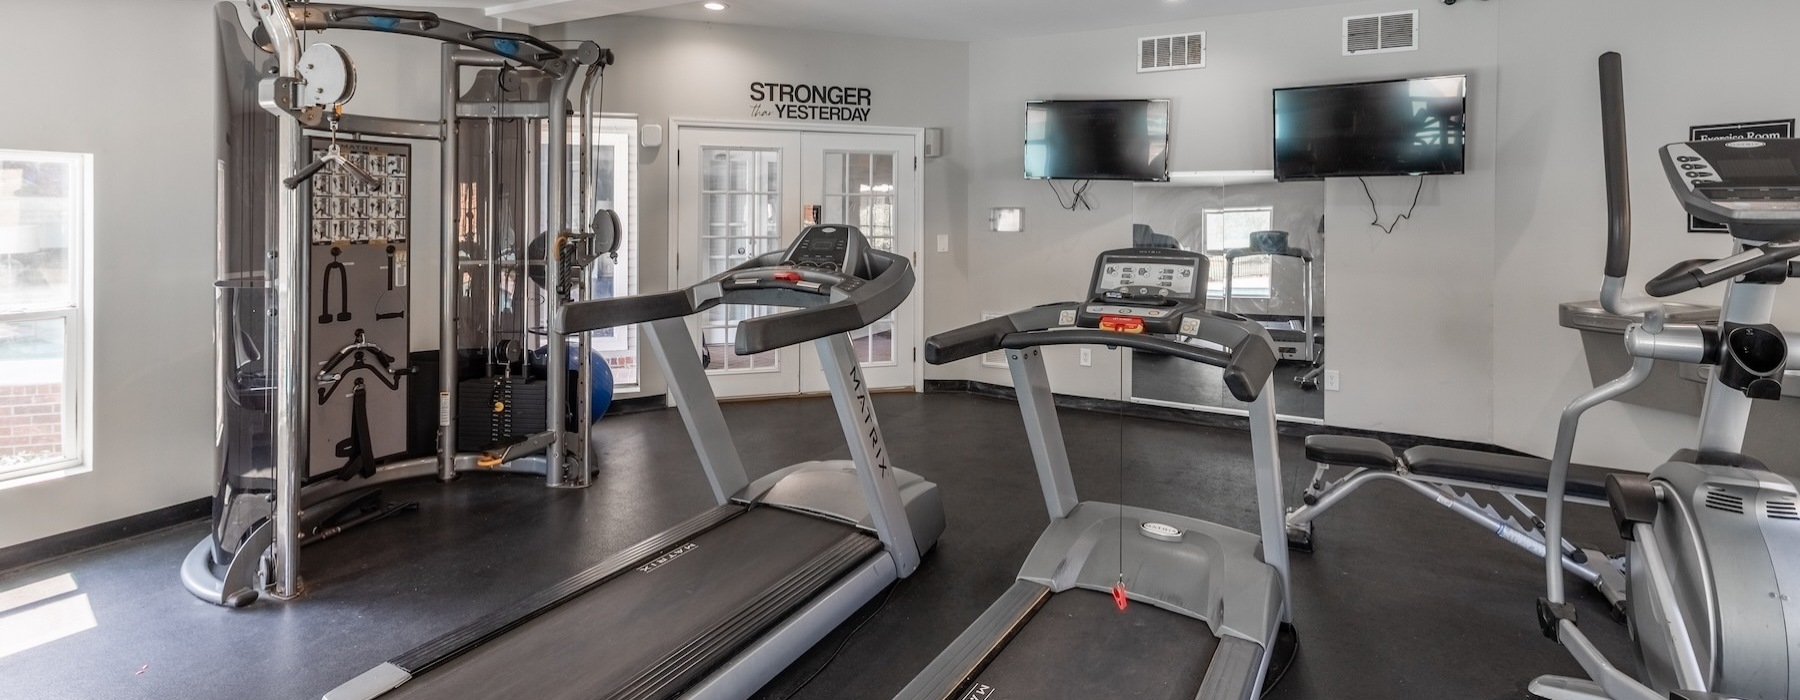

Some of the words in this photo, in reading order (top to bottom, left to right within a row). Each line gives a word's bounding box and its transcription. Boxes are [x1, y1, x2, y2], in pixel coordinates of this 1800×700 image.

[750, 82, 871, 106] STRONGER
[775, 104, 871, 121] YESTERDAY
[849, 366, 887, 479] MATRIX
[640, 542, 697, 573] MATRIX
